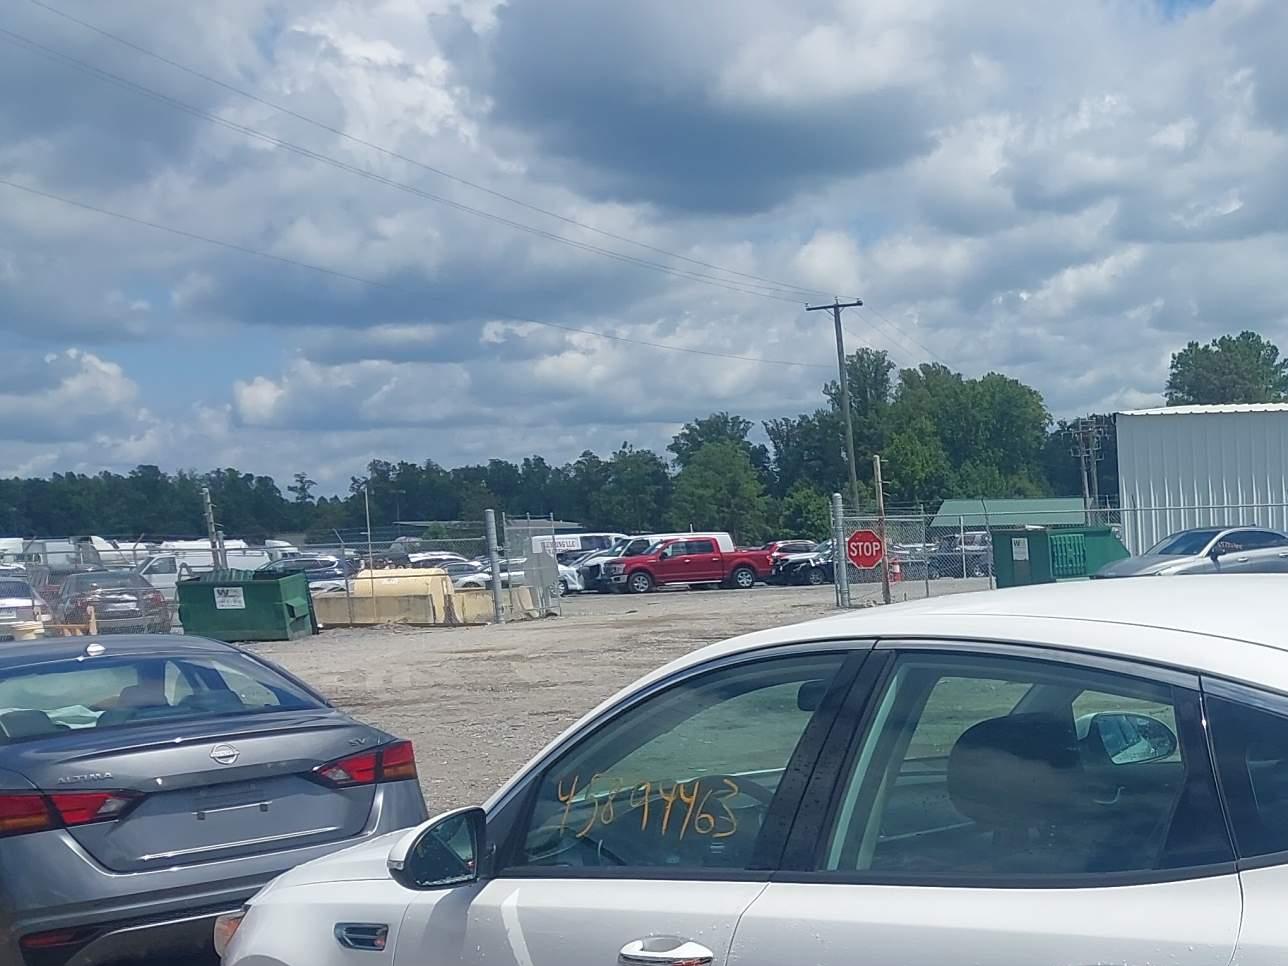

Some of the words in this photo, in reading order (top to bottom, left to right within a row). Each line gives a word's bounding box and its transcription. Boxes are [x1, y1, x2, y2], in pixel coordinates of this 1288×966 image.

[850, 542, 881, 557] STOP
[57, 772, 113, 784] ALTIMA
[558, 774, 738, 841] 45894463
